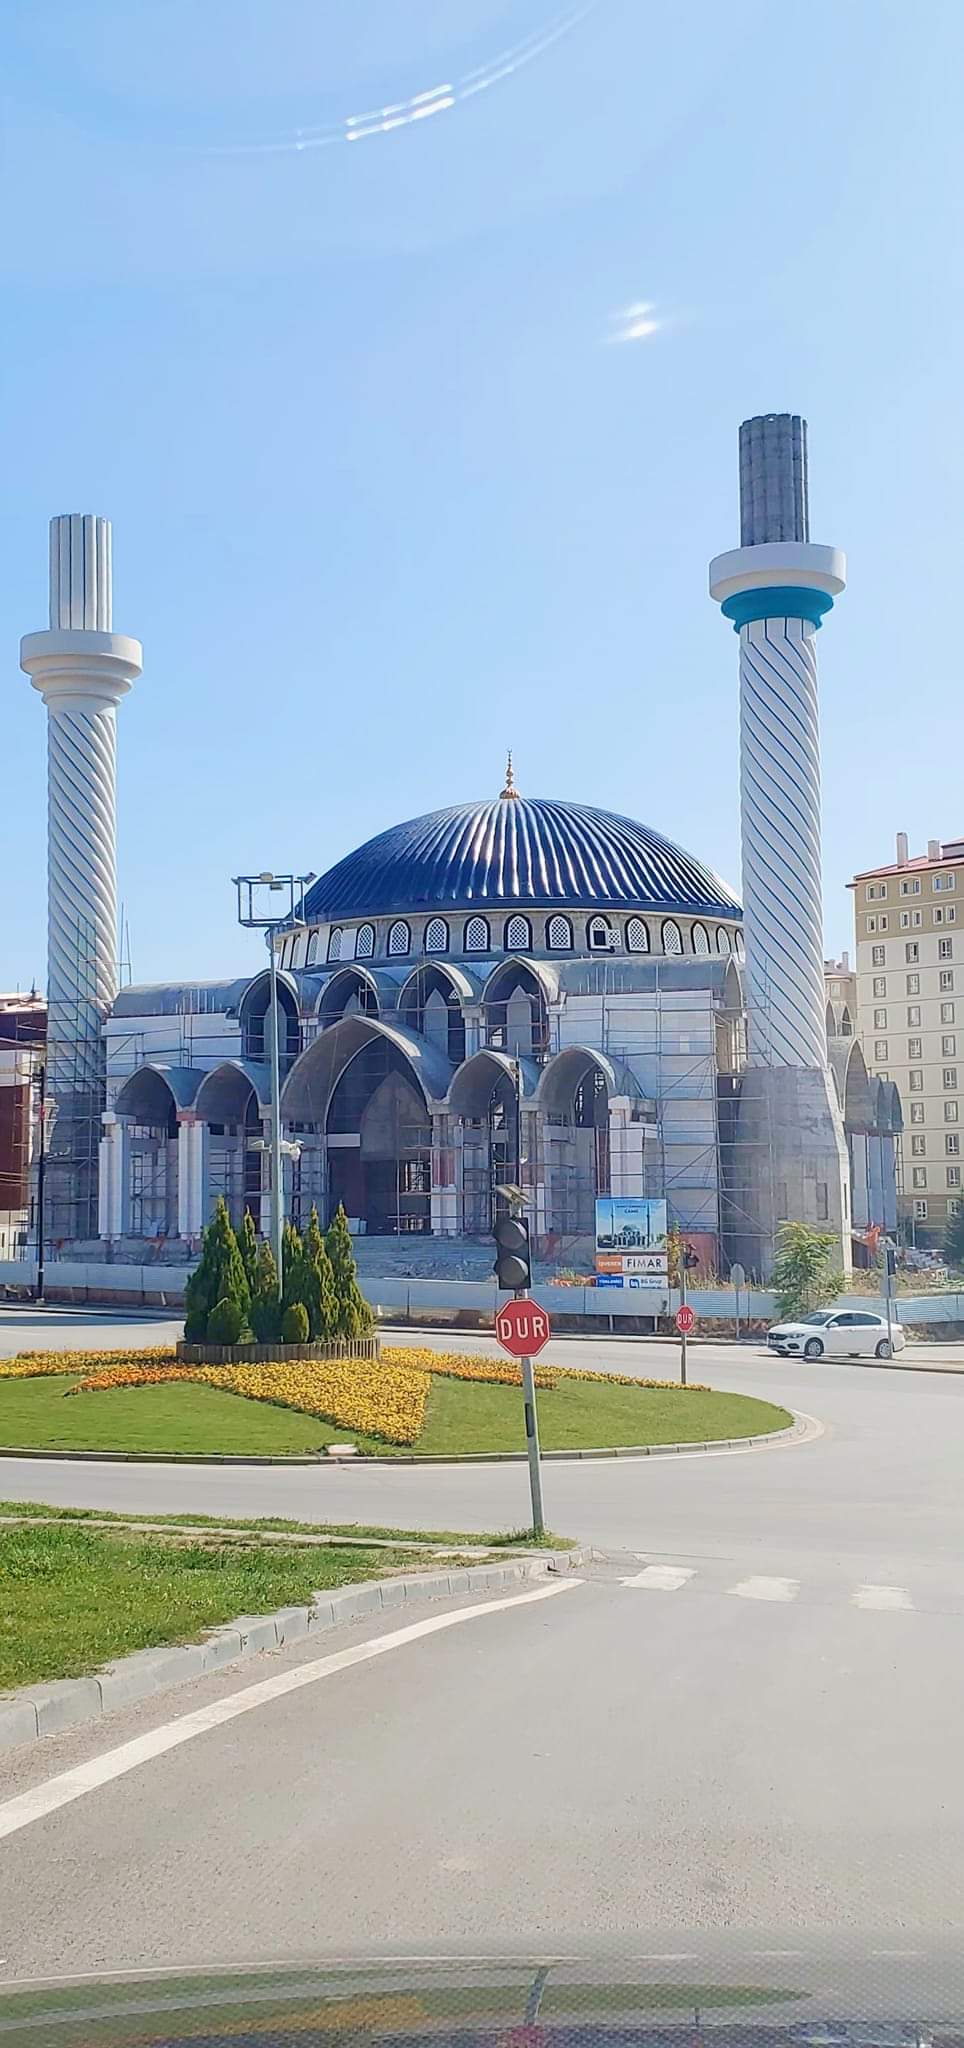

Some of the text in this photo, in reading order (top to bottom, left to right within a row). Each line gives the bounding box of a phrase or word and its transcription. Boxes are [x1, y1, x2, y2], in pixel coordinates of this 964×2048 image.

[627, 1258, 662, 1268] FIMAR
[677, 1313, 693, 1323] DUR
[499, 1316, 545, 1340] DUR
